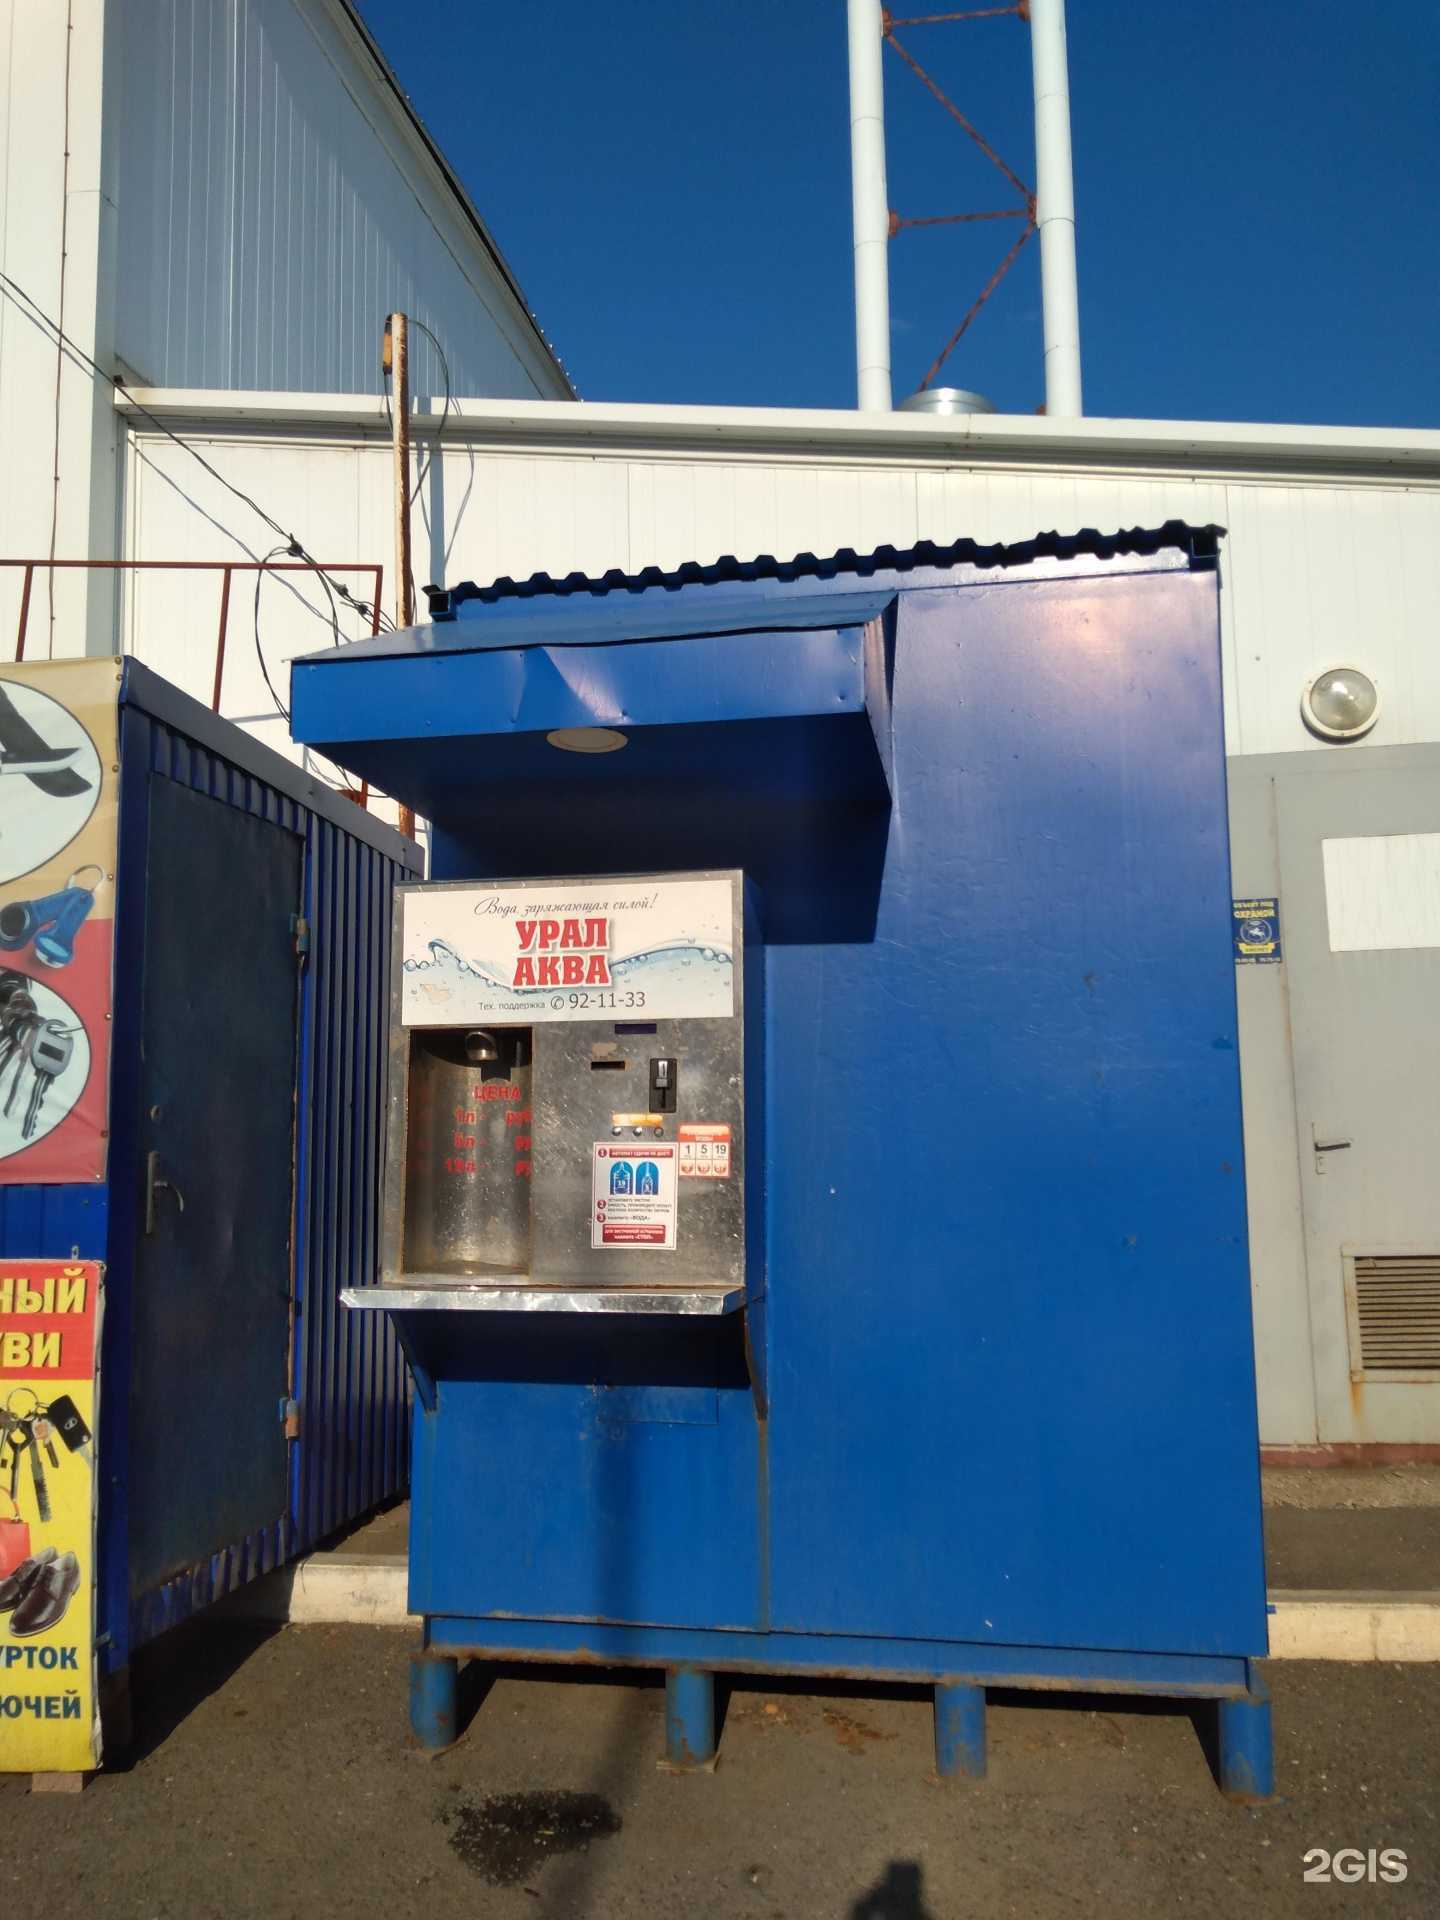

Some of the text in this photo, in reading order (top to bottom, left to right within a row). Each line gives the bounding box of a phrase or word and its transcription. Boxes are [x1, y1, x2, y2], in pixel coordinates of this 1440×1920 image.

[523, 902, 608, 917] заряжающая
[612, 892, 659, 909] силой!
[515, 918, 608, 950] УРАЛ
[512, 955, 609, 987] АКВА
[498, 1002, 546, 1011] поддержка
[569, 992, 646, 1009] 92-11-33
[474, 1086, 520, 1101] ЦЕНА
[701, 1144, 708, 1154] 5
[716, 1145, 727, 1154] 19
[0, 1331, 61, 1368] ВИ
[0, 1646, 78, 1670] РТОК
